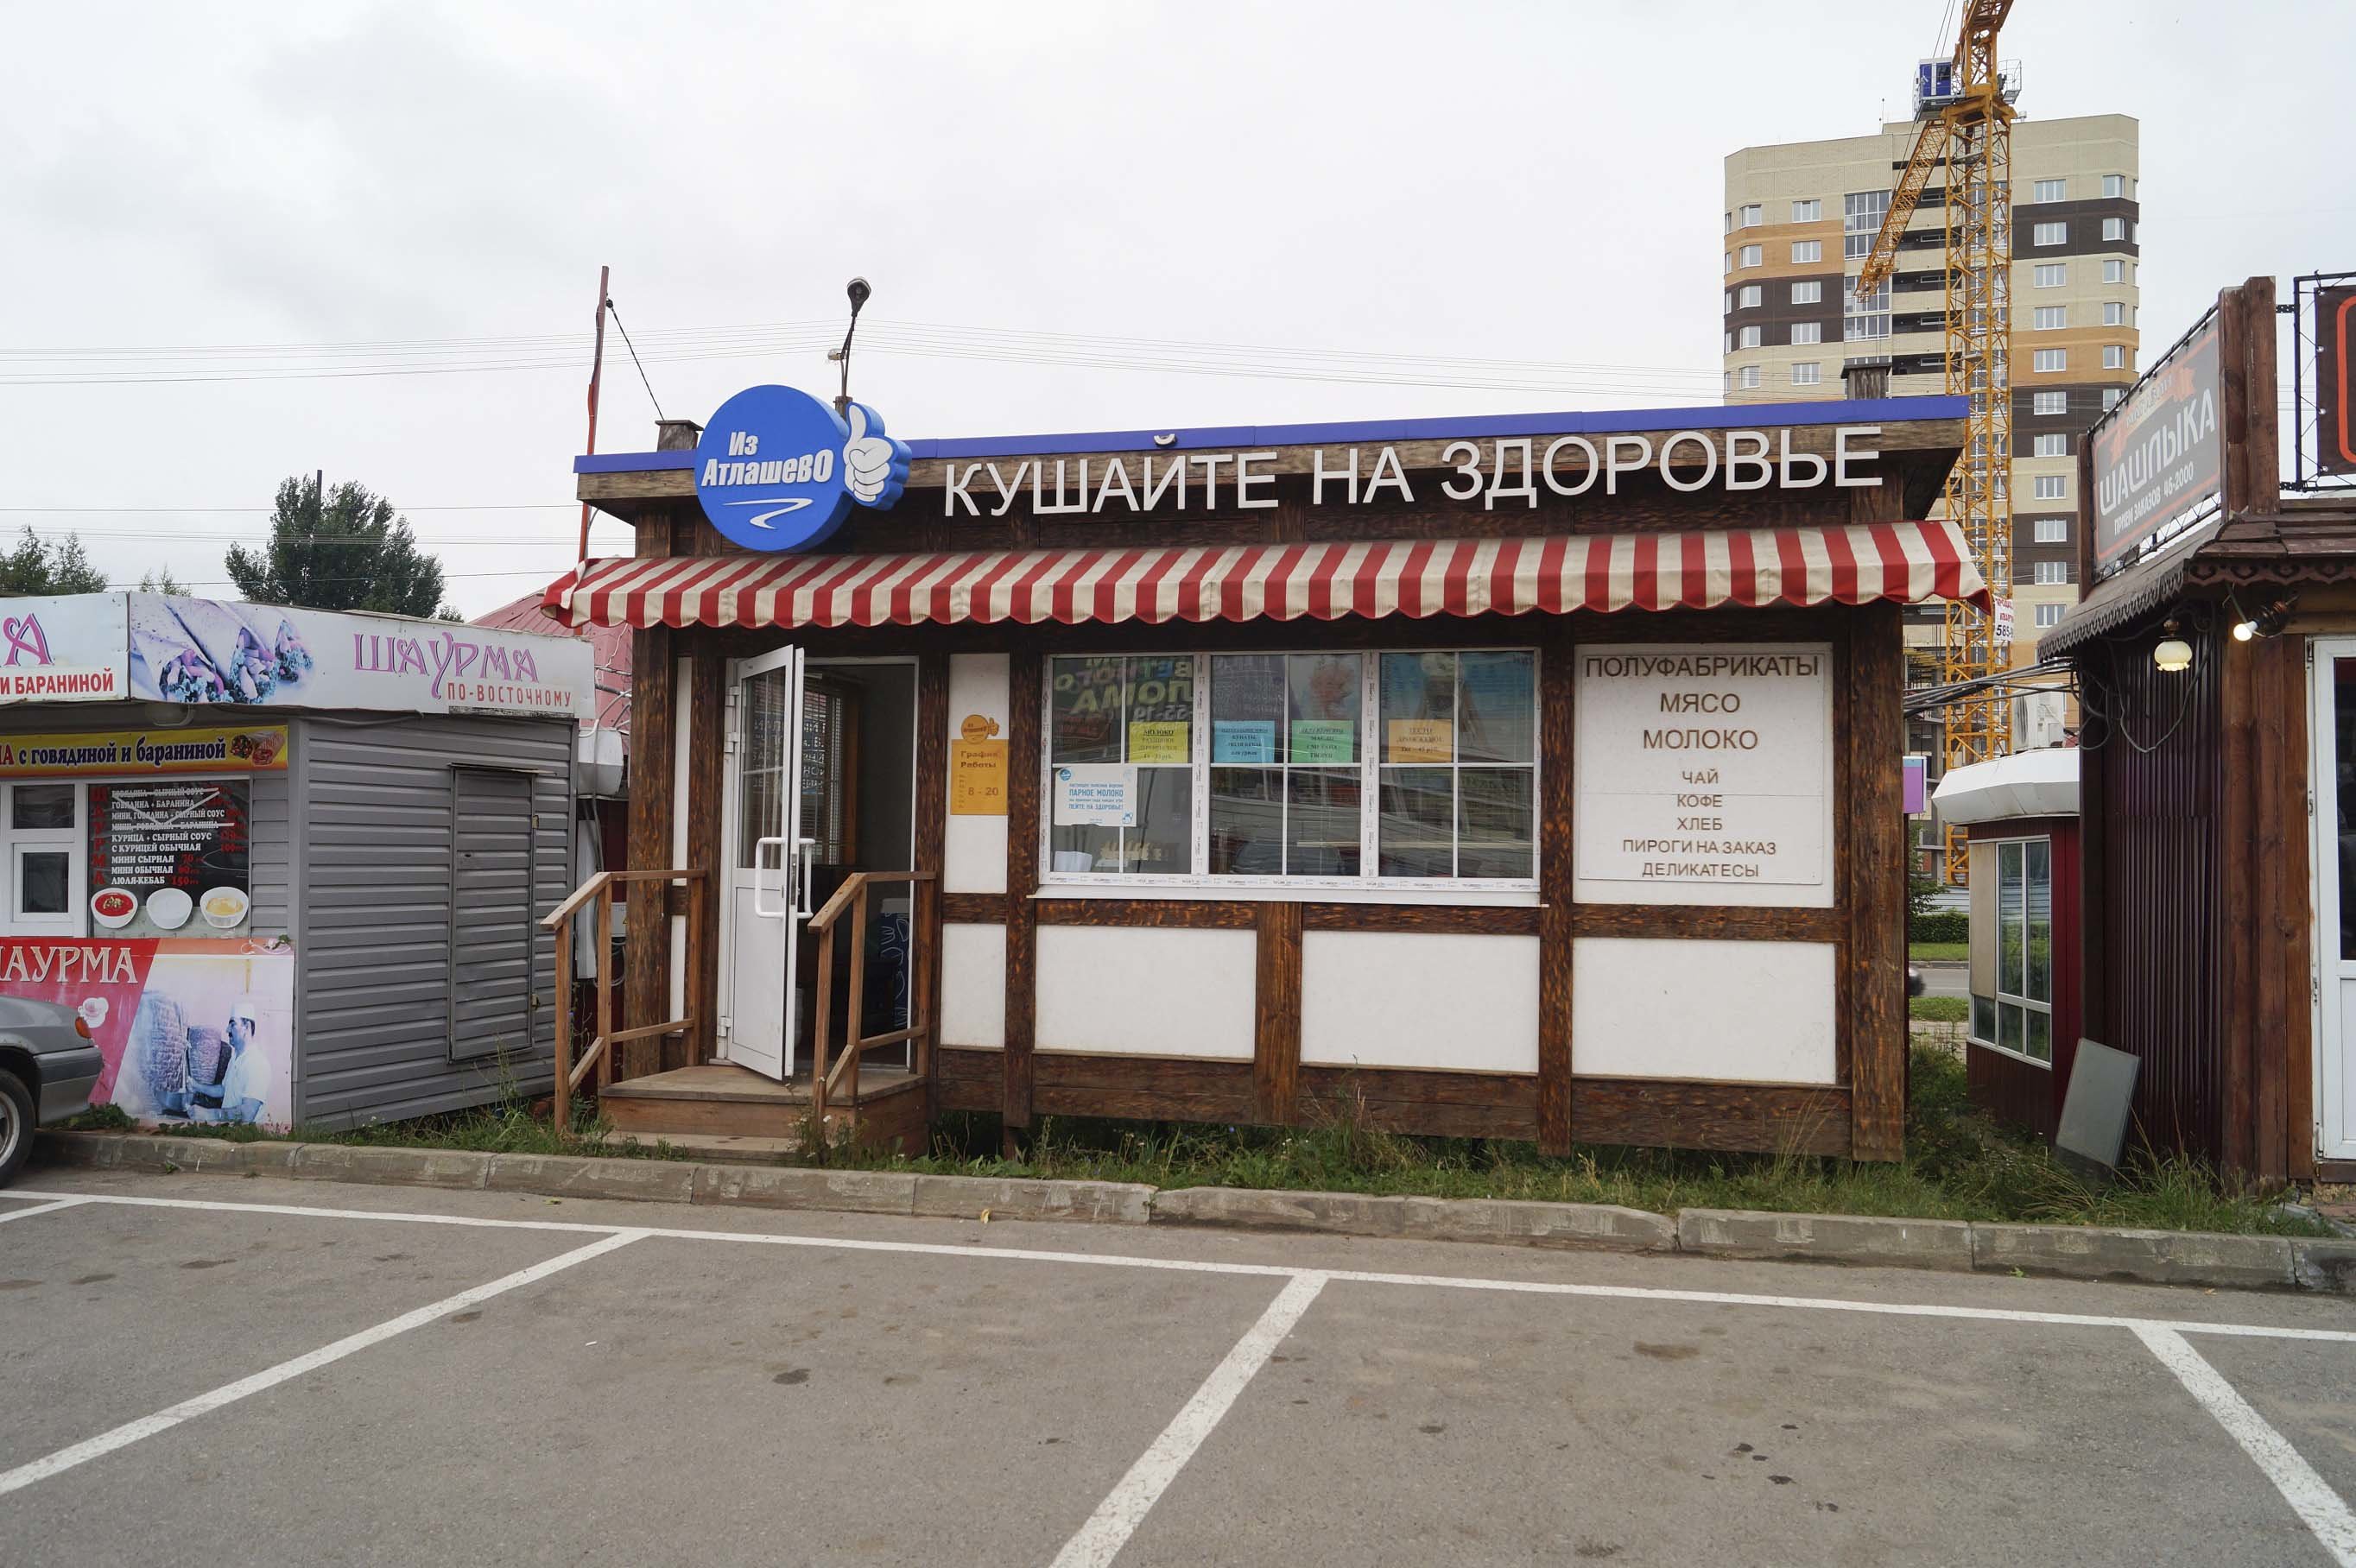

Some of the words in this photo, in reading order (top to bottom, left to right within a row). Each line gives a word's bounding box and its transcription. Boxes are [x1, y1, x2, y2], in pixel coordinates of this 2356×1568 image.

[728, 431, 758, 456] Из
[2100, 388, 2215, 516] ШАШЛЫКА
[1314, 446, 1416, 505] НА
[1441, 426, 1884, 511] ЗДОРОВЬЕ
[353, 631, 540, 700] ШАУРМА
[1586, 655, 1819, 678] ПОЛУФАБРИКАТЫ
[15, 667, 114, 695] БАРАНИНОЙ
[447, 682, 572, 707] ПО-ВОСТОЧНОМУ
[1660, 693, 1740, 713] МЯСО
[1644, 729, 1758, 750] МОЛОКО
[0, 744, 15, 766] А
[31, 742, 117, 767] говядиной
[121, 746, 131, 762] и
[136, 735, 226, 767] бараниной
[1682, 768, 1719, 785] ЧАЙ
[968, 787, 975, 795] 8
[985, 787, 998, 795] 20
[156, 800, 194, 808] БАРАНИНА
[1677, 794, 1723, 808] КОФЕ
[1677, 818, 1722, 831] ХЛЕБ
[111, 834, 144, 843] КУРИЦА
[152, 831, 188, 842] СЫРНЫЙ
[190, 832, 212, 841] СОУС
[118, 843, 157, 853] КУРИЦЕЙ
[159, 844, 201, 852] ОБЫЧНАЯ
[1623, 839, 1693, 853] ПИРОГИ
[1697, 840, 1719, 854] НА
[1722, 841, 1776, 855] ЗАКАЗ
[111, 855, 136, 863] МИНИ
[137, 854, 174, 863] СЫРНАЯ
[111, 866, 133, 875] МИНИ
[1642, 863, 1759, 878] ДЕЛИКАТЕСЫ
[111, 876, 165, 885] ЛЮЛЯ-КЕБАБ
[0, 945, 138, 983] АУРМА
